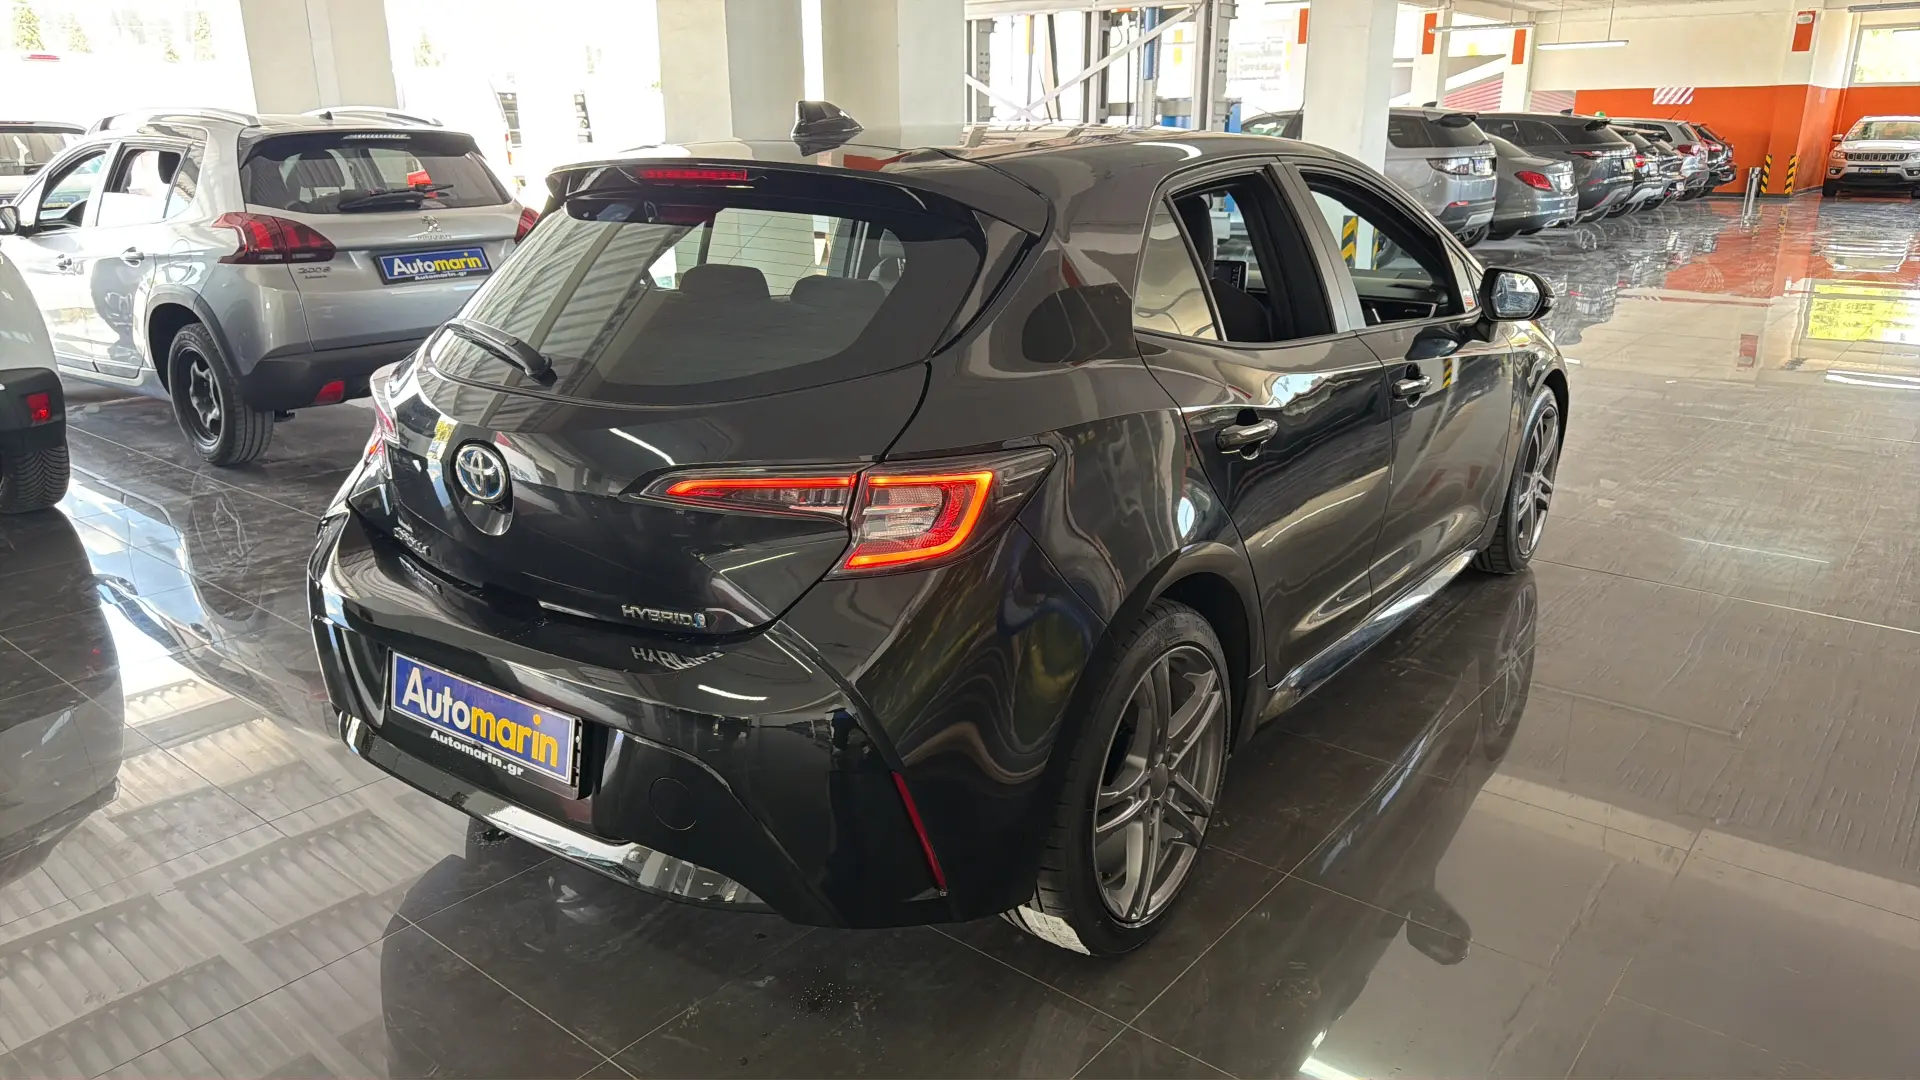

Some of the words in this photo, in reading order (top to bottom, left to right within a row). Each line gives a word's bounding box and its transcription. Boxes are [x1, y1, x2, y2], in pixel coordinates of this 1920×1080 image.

[393, 252, 483, 276] Automarin
[414, 271, 468, 281] Automarin.gr
[621, 604, 693, 626] HYBRID
[402, 666, 558, 768] Automarin
[430, 729, 524, 776] Automarin.gr
